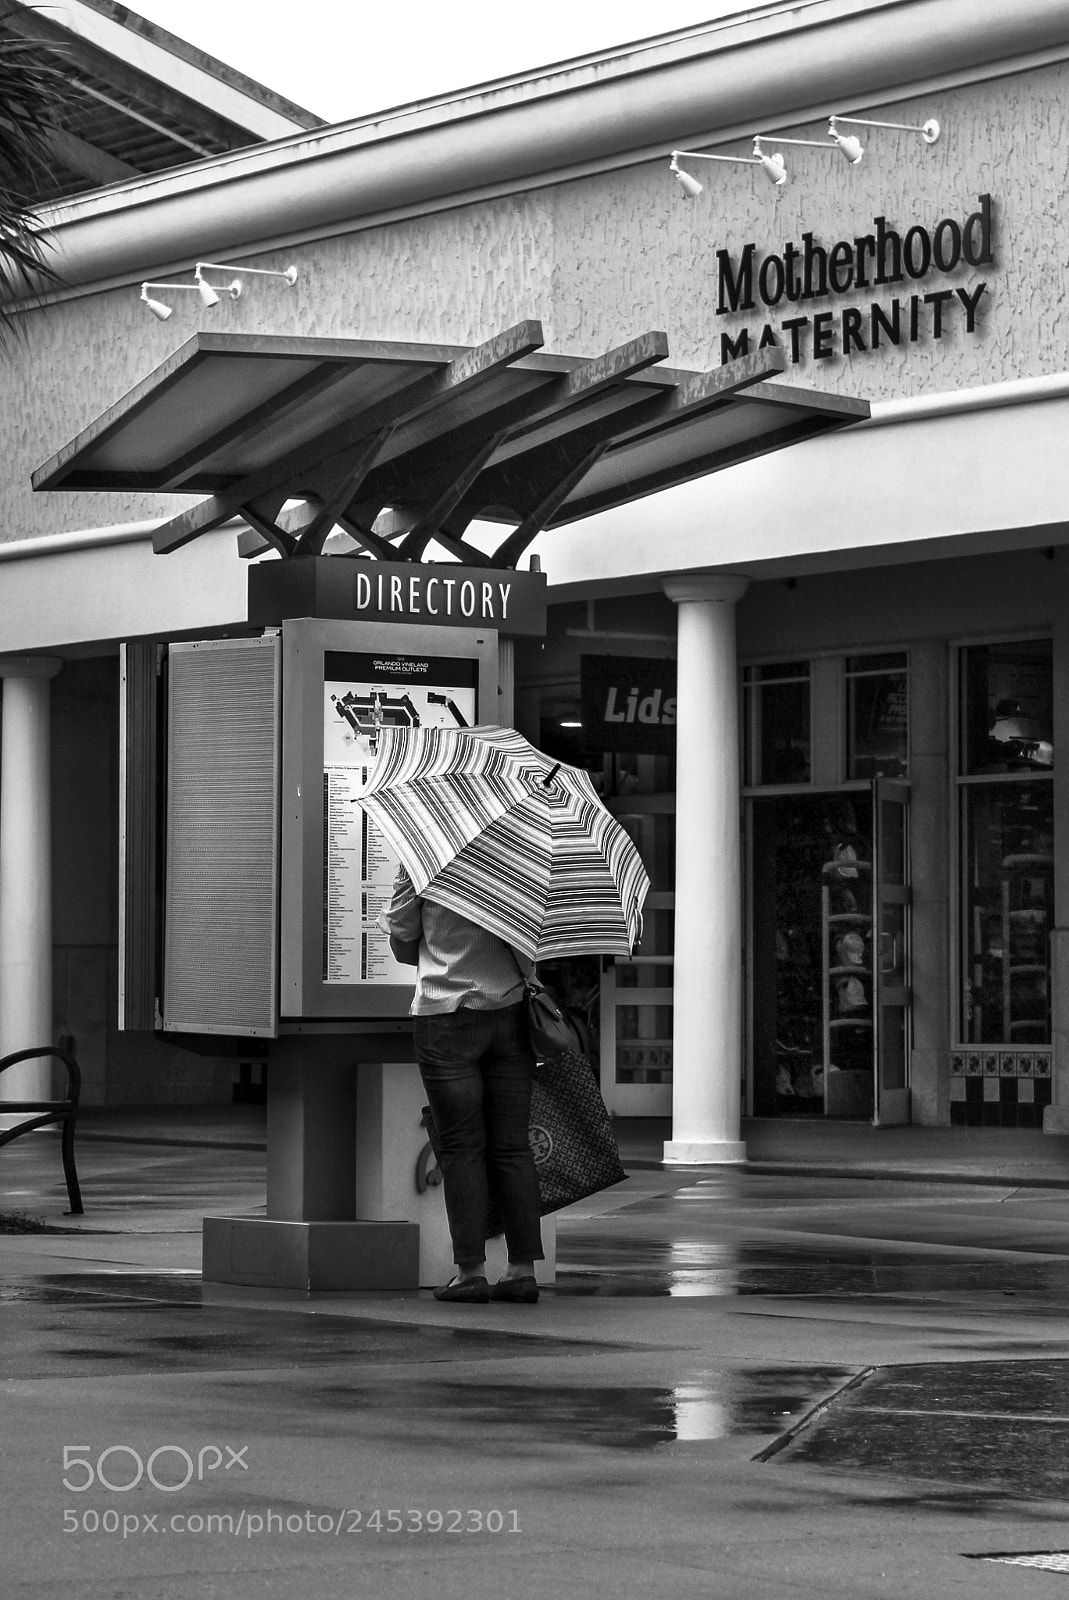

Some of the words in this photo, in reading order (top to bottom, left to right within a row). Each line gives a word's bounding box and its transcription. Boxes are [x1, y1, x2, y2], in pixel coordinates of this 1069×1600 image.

[716, 193, 994, 316] Motherhood
[356, 572, 512, 619] DIRECTORY
[604, 687, 677, 725] Lids
